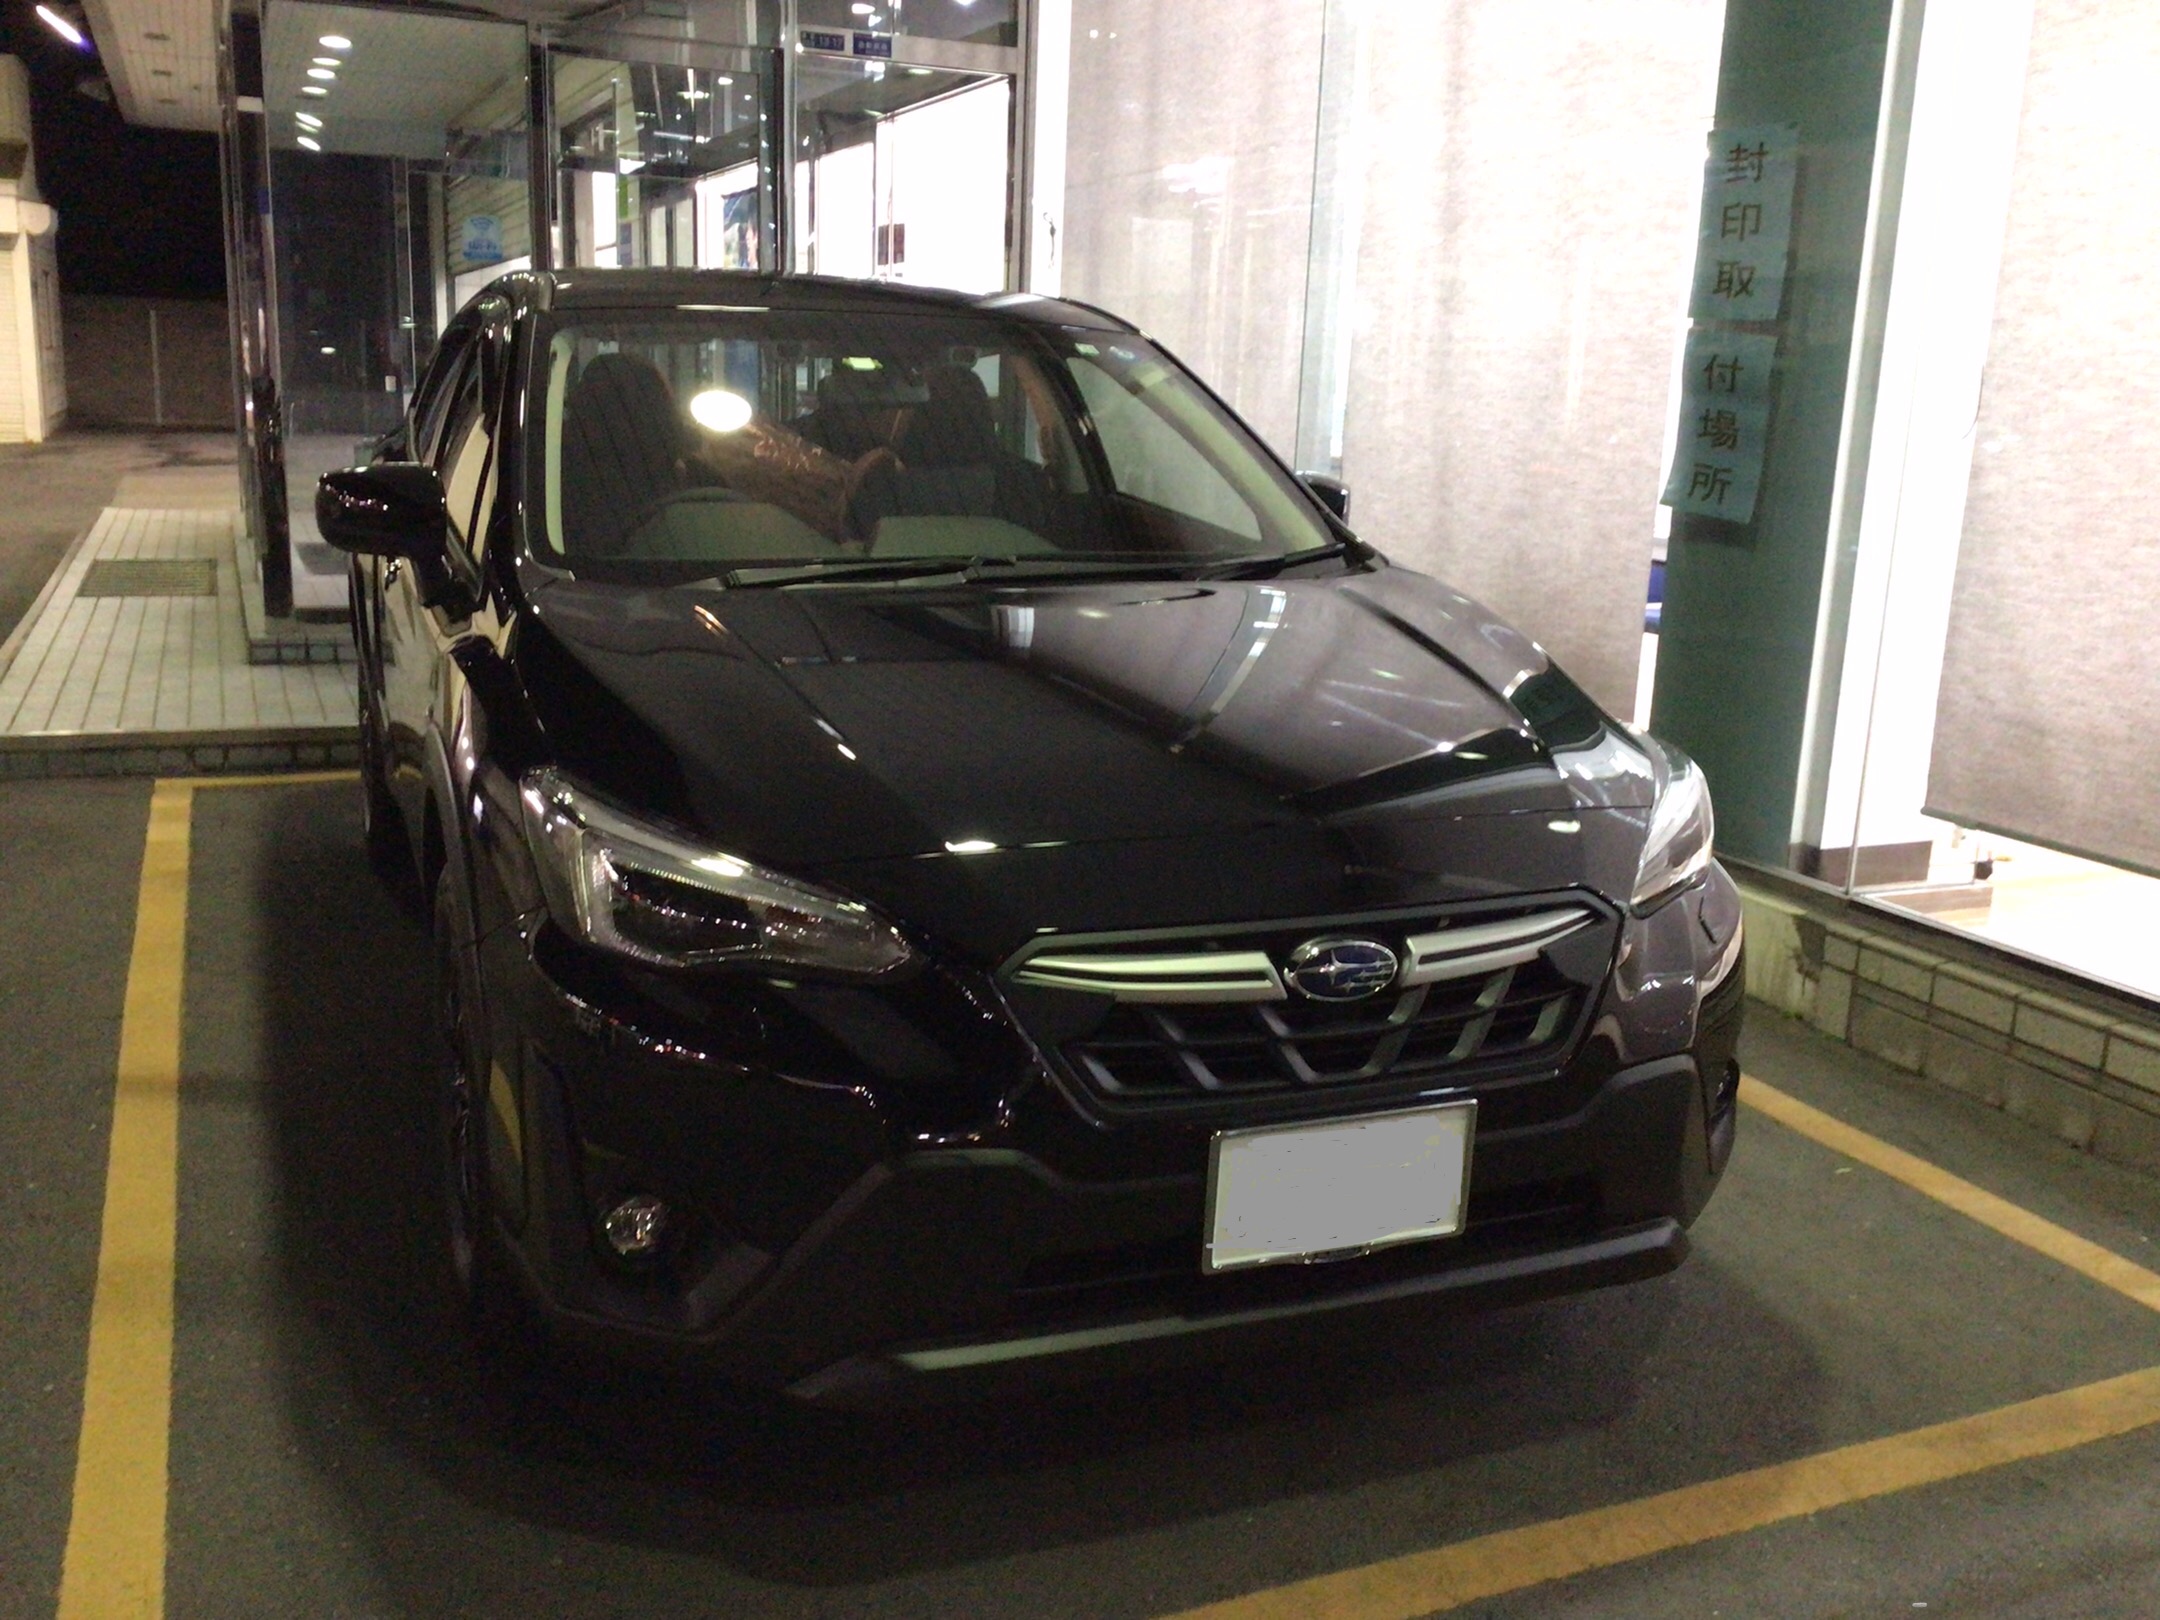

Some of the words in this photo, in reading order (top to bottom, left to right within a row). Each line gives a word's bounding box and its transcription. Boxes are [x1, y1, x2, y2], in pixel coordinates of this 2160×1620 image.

[1688, 142, 1769, 505] 封印取付場所
